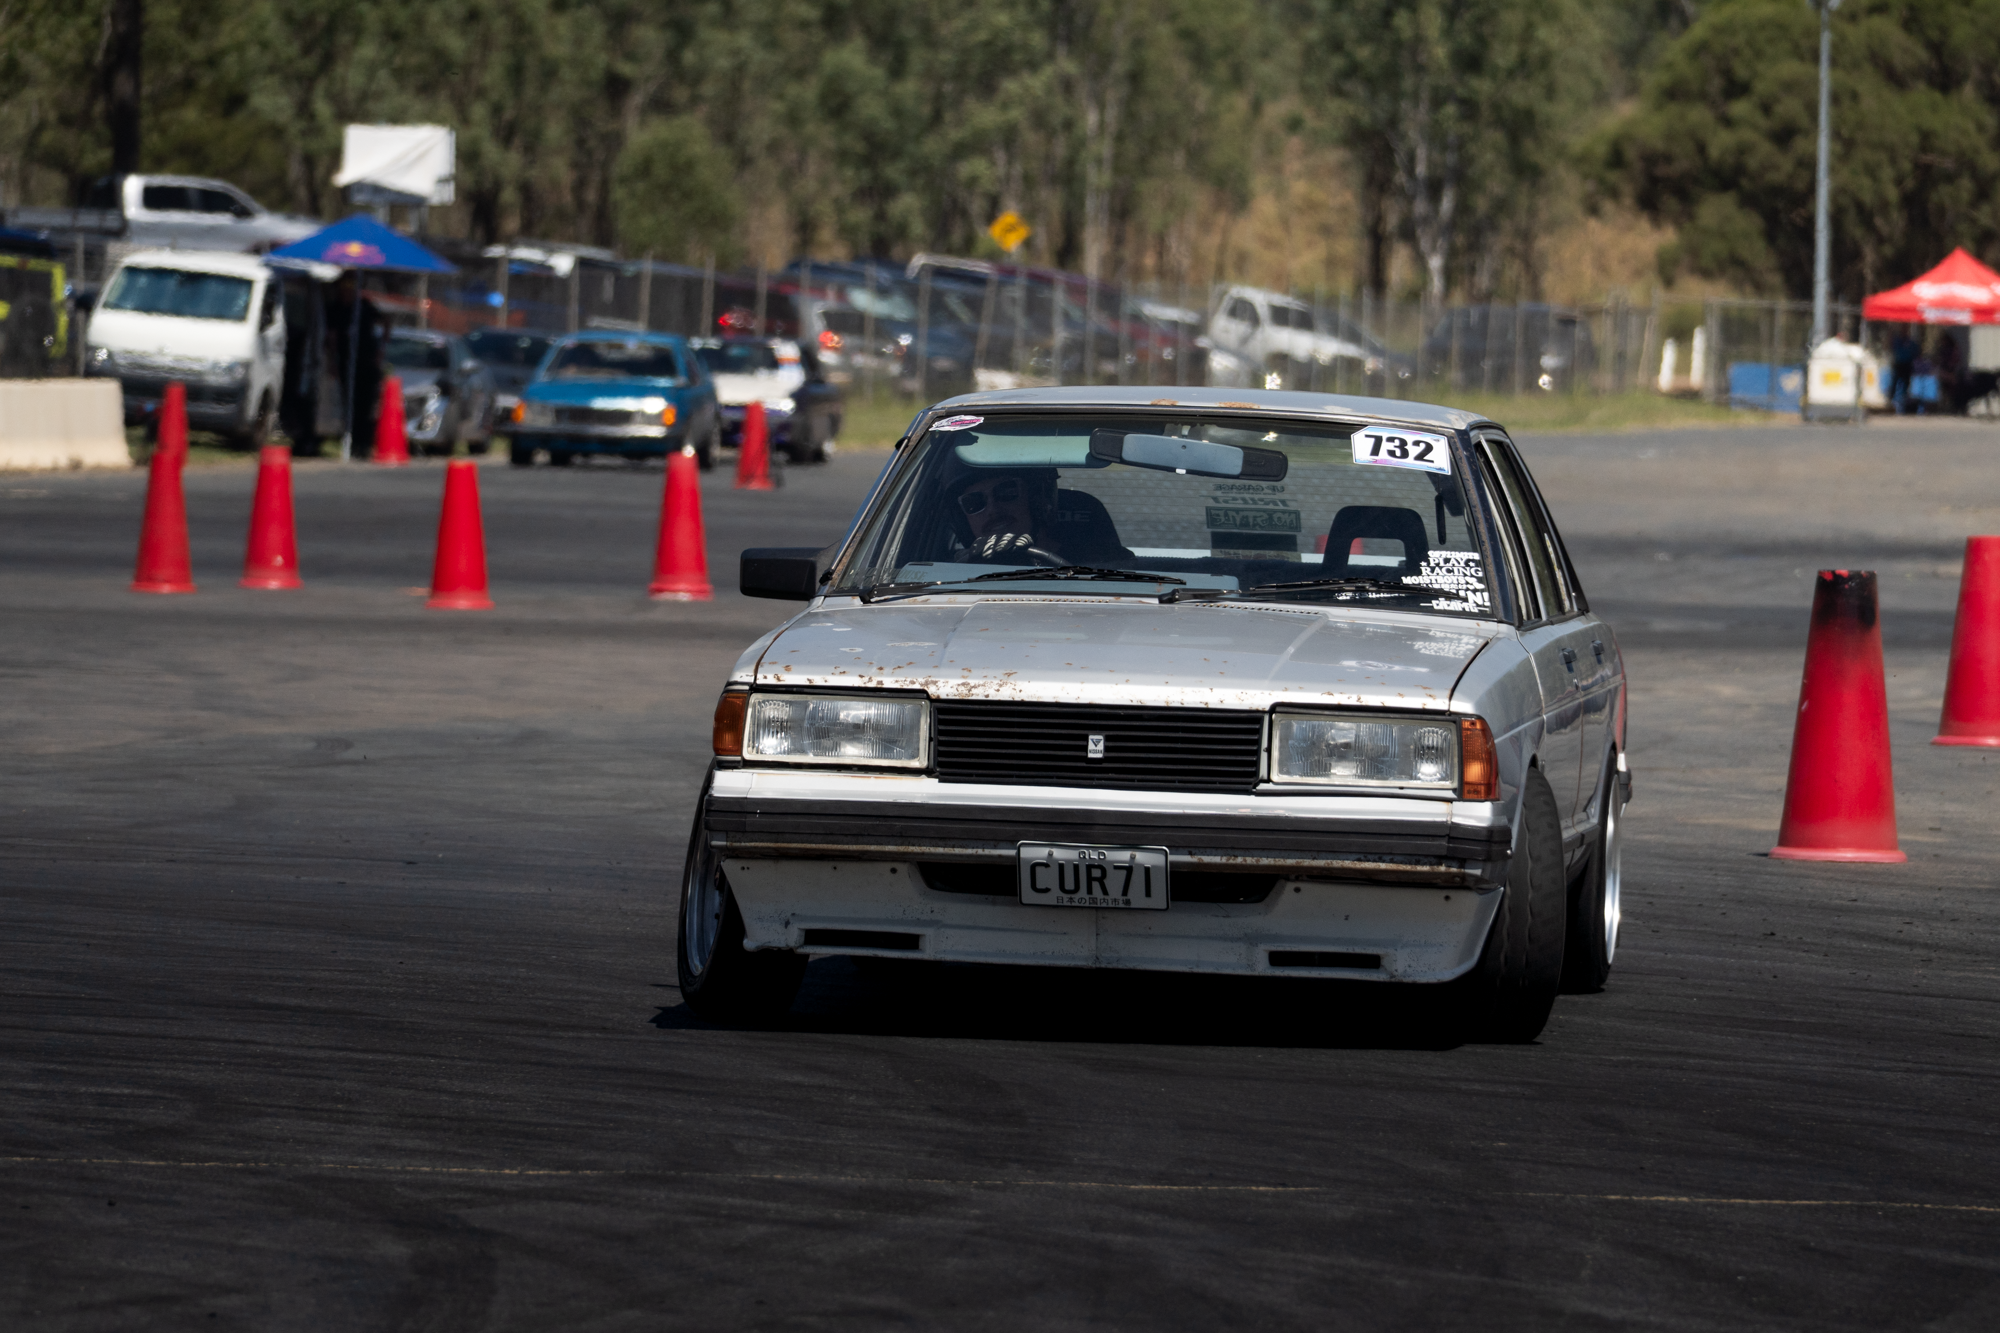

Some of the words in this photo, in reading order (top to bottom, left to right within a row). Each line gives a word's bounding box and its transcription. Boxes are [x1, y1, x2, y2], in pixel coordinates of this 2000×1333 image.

[1364, 434, 1435, 464] 732
[1428, 557, 1467, 567] PLAY
[1420, 566, 1483, 577] RACING
[1401, 575, 1466, 585] MOISTBOYS
[1078, 849, 1108, 860] QLD
[1056, 895, 1132, 907] 日本の国内市場
